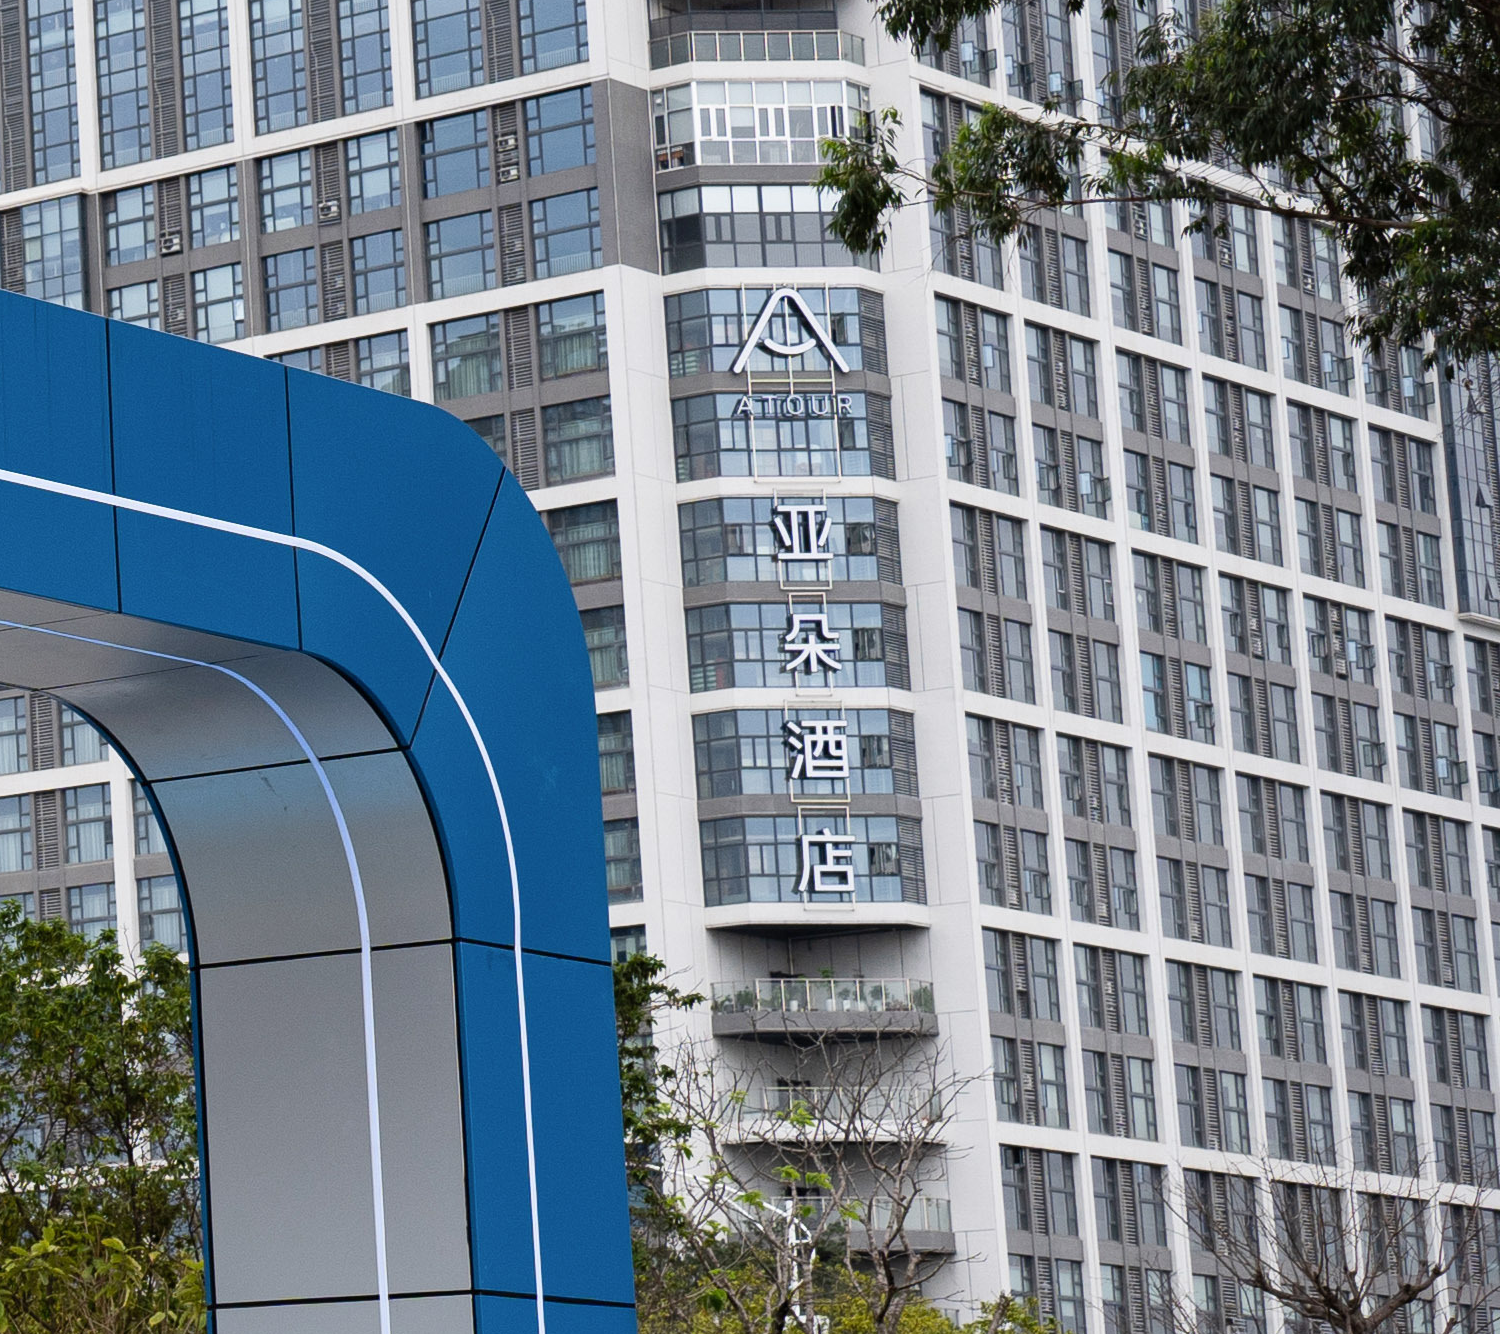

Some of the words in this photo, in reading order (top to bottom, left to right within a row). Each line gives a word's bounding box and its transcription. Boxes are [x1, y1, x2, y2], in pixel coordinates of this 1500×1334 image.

[737, 395, 853, 415] ATOUR
[774, 505, 856, 893] 亚朵酒店
